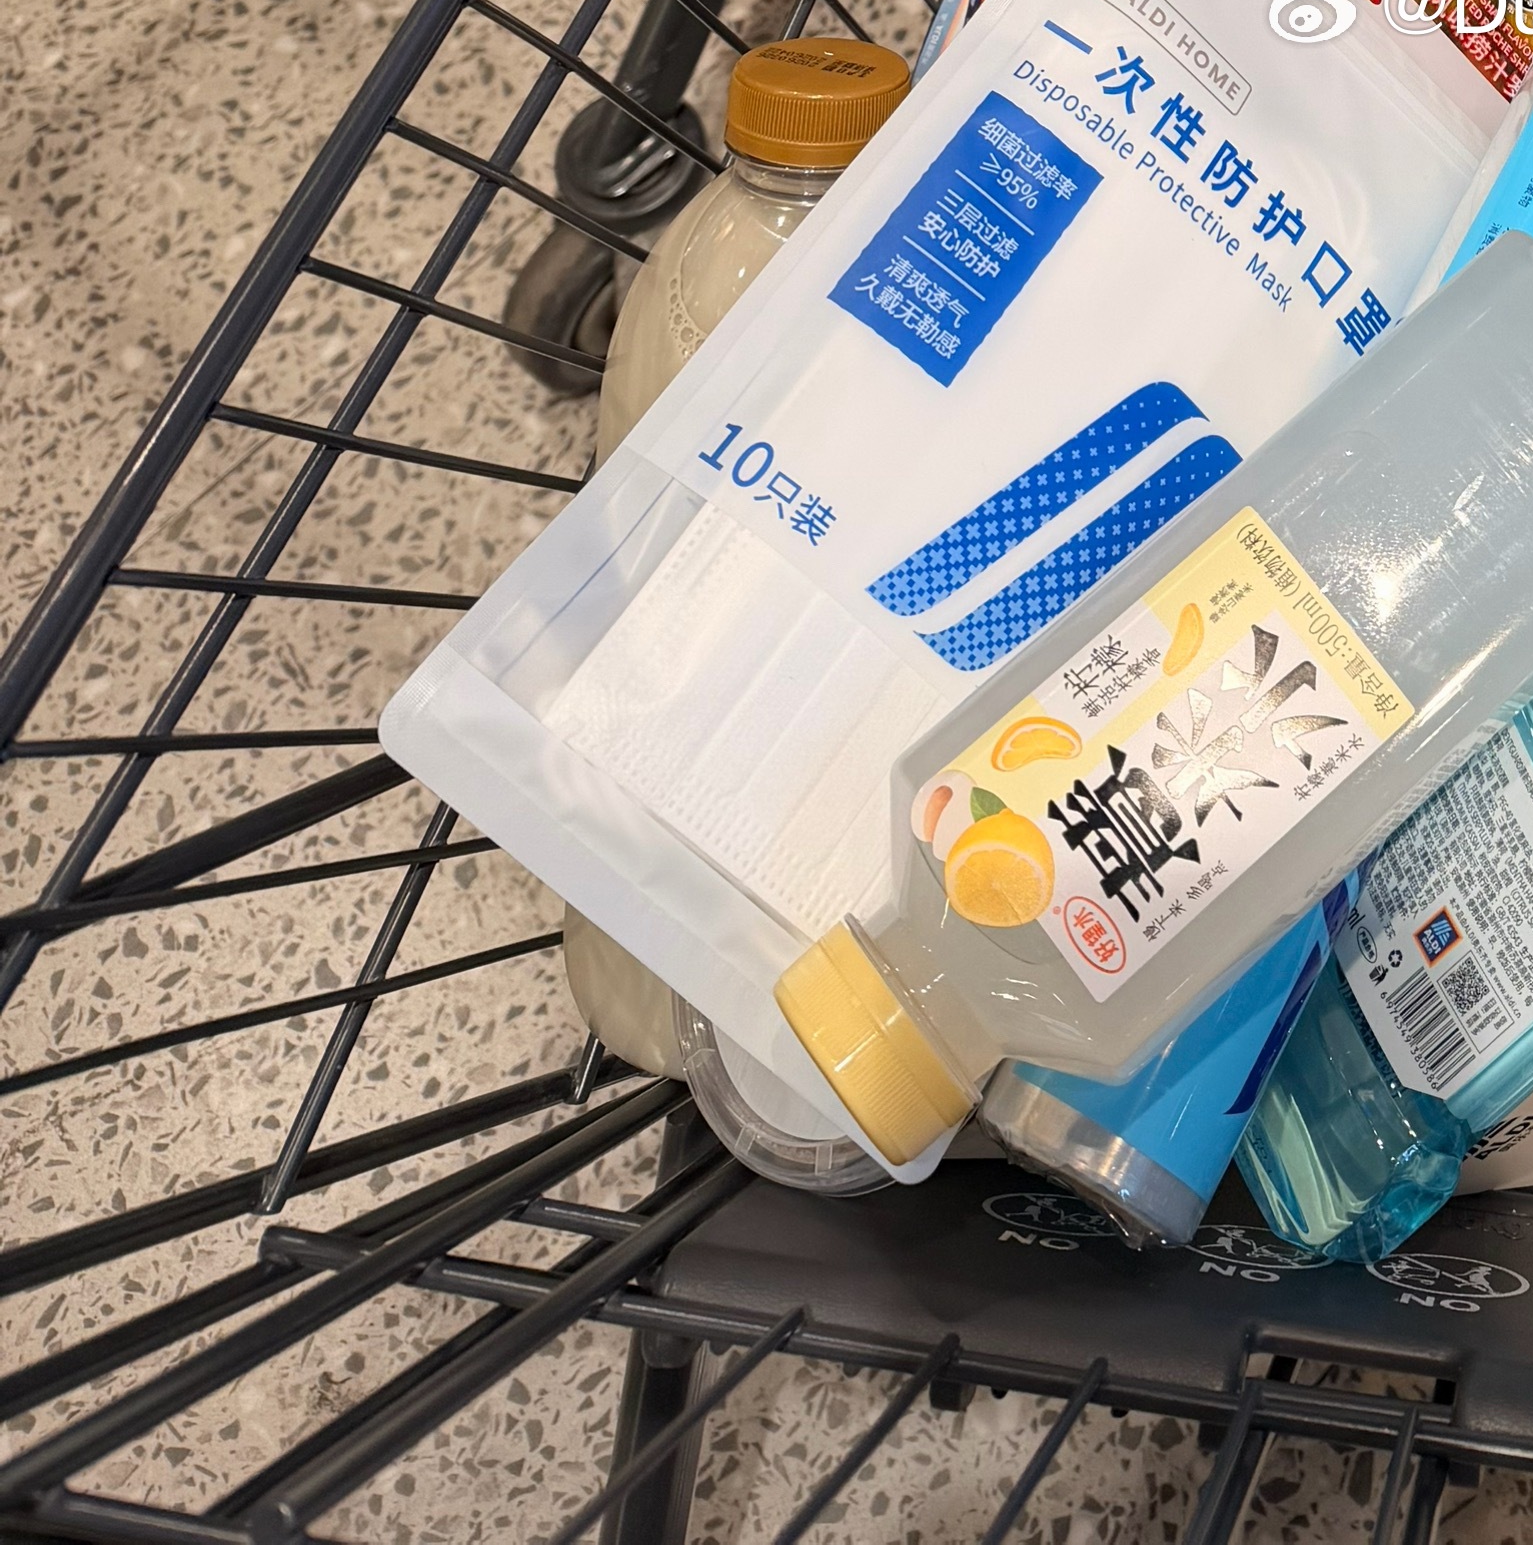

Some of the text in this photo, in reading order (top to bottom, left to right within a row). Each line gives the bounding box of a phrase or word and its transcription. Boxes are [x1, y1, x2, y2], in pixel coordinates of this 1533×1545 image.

[1176, 33, 1242, 102] HOME
[978, 117, 1079, 201] 细菌过滤率
[1013, 59, 1294, 314] Disposable Protective Mask
[1043, 20, 1392, 357] 一次性防护口罩
[917, 211, 1001, 279] 安心防护
[936, 188, 1019, 262] 三层过滤
[854, 272, 962, 360] 久戴无勒感
[883, 253, 970, 329] 清爽透气
[697, 421, 840, 548] 10只装
[1062, 632, 1130, 701] 柠檬
[1081, 646, 1162, 720] 鲜活柠檬香
[1046, 623, 1349, 923] 薏米水
[1290, 730, 1368, 804] 柠檬薏米水
[1072, 907, 1121, 966] 好望水
[1140, 858, 1231, 944] 慢下来 多喝点
[1423, 927, 1443, 954] ALDI
[1491, 974, 1524, 1019] www.aldi.cn
[998, 1229, 1080, 1252] NO
[1200, 1262, 1281, 1284] NO
[1399, 1293, 1482, 1313] NO
